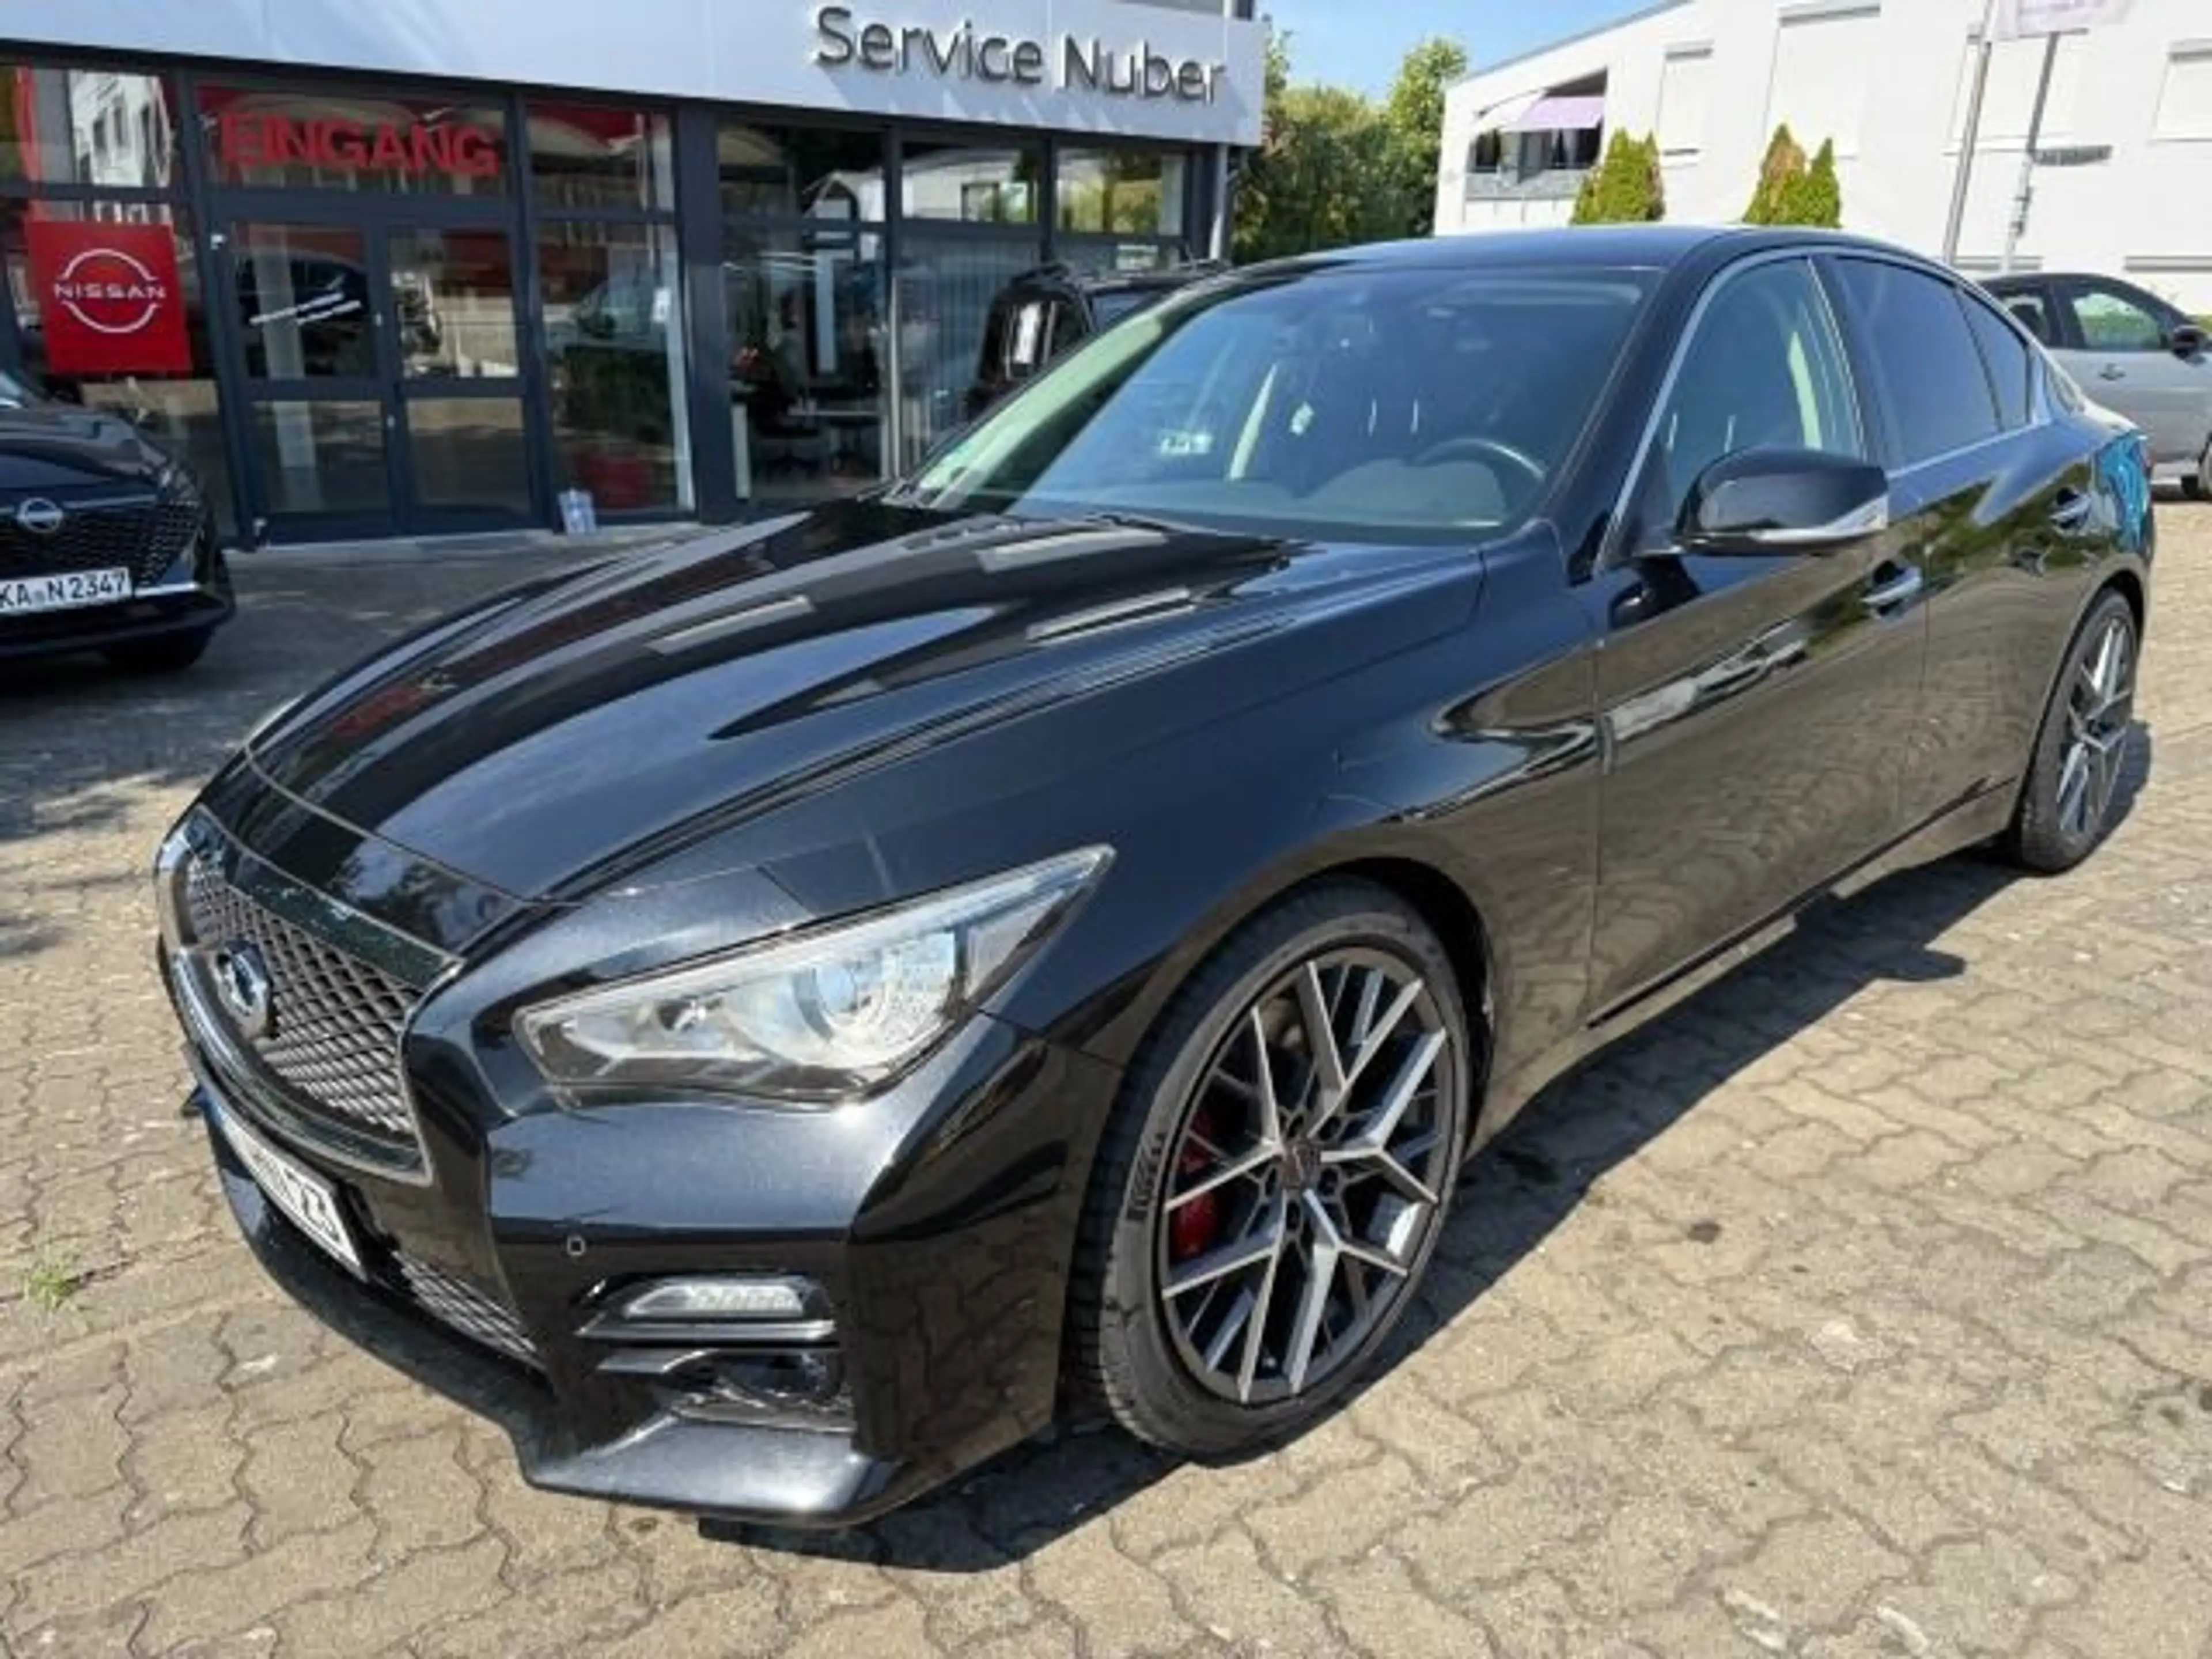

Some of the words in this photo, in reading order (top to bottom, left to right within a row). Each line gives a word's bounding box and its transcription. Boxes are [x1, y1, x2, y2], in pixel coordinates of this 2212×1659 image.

[817, 7, 1043, 85] Service
[1059, 35, 1225, 104] Nuber
[222, 112, 499, 177] EINGANG
[54, 282, 165, 300] NISSAN
